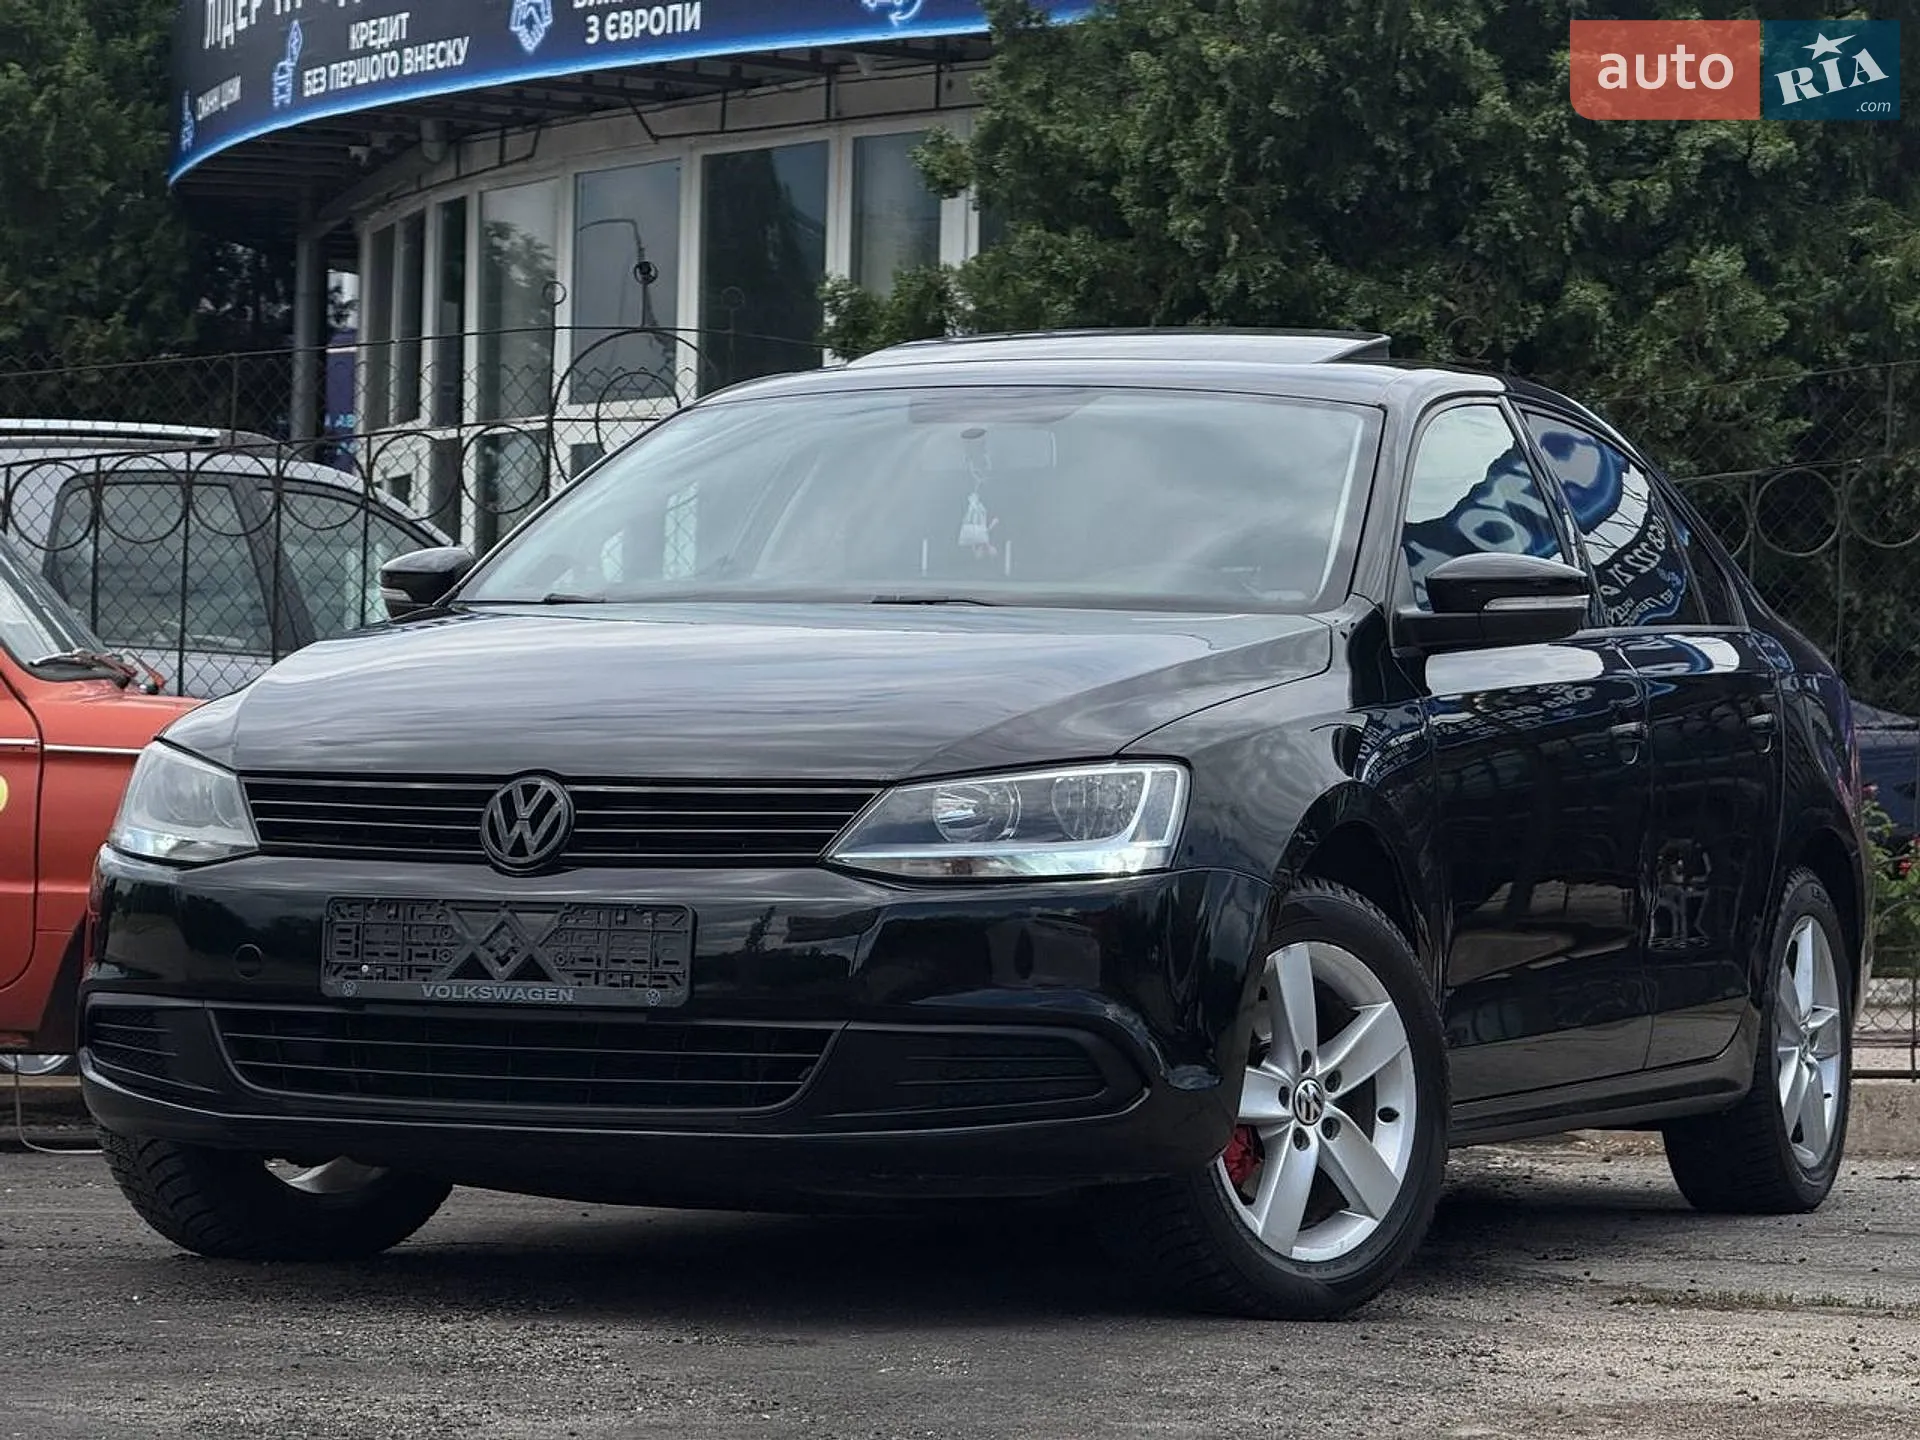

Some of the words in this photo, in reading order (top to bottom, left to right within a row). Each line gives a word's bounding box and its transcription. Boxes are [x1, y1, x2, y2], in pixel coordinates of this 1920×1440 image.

[349, 12, 410, 51] КРЕДИТ
[604, 1, 701, 42] ЄВРОПИ
[303, 66, 327, 97] БЕЗ
[328, 50, 400, 91] ПЕРШОГО
[402, 36, 470, 75] ВНЕСКУ
[421, 983, 575, 1003] VOLKSWAGEN
